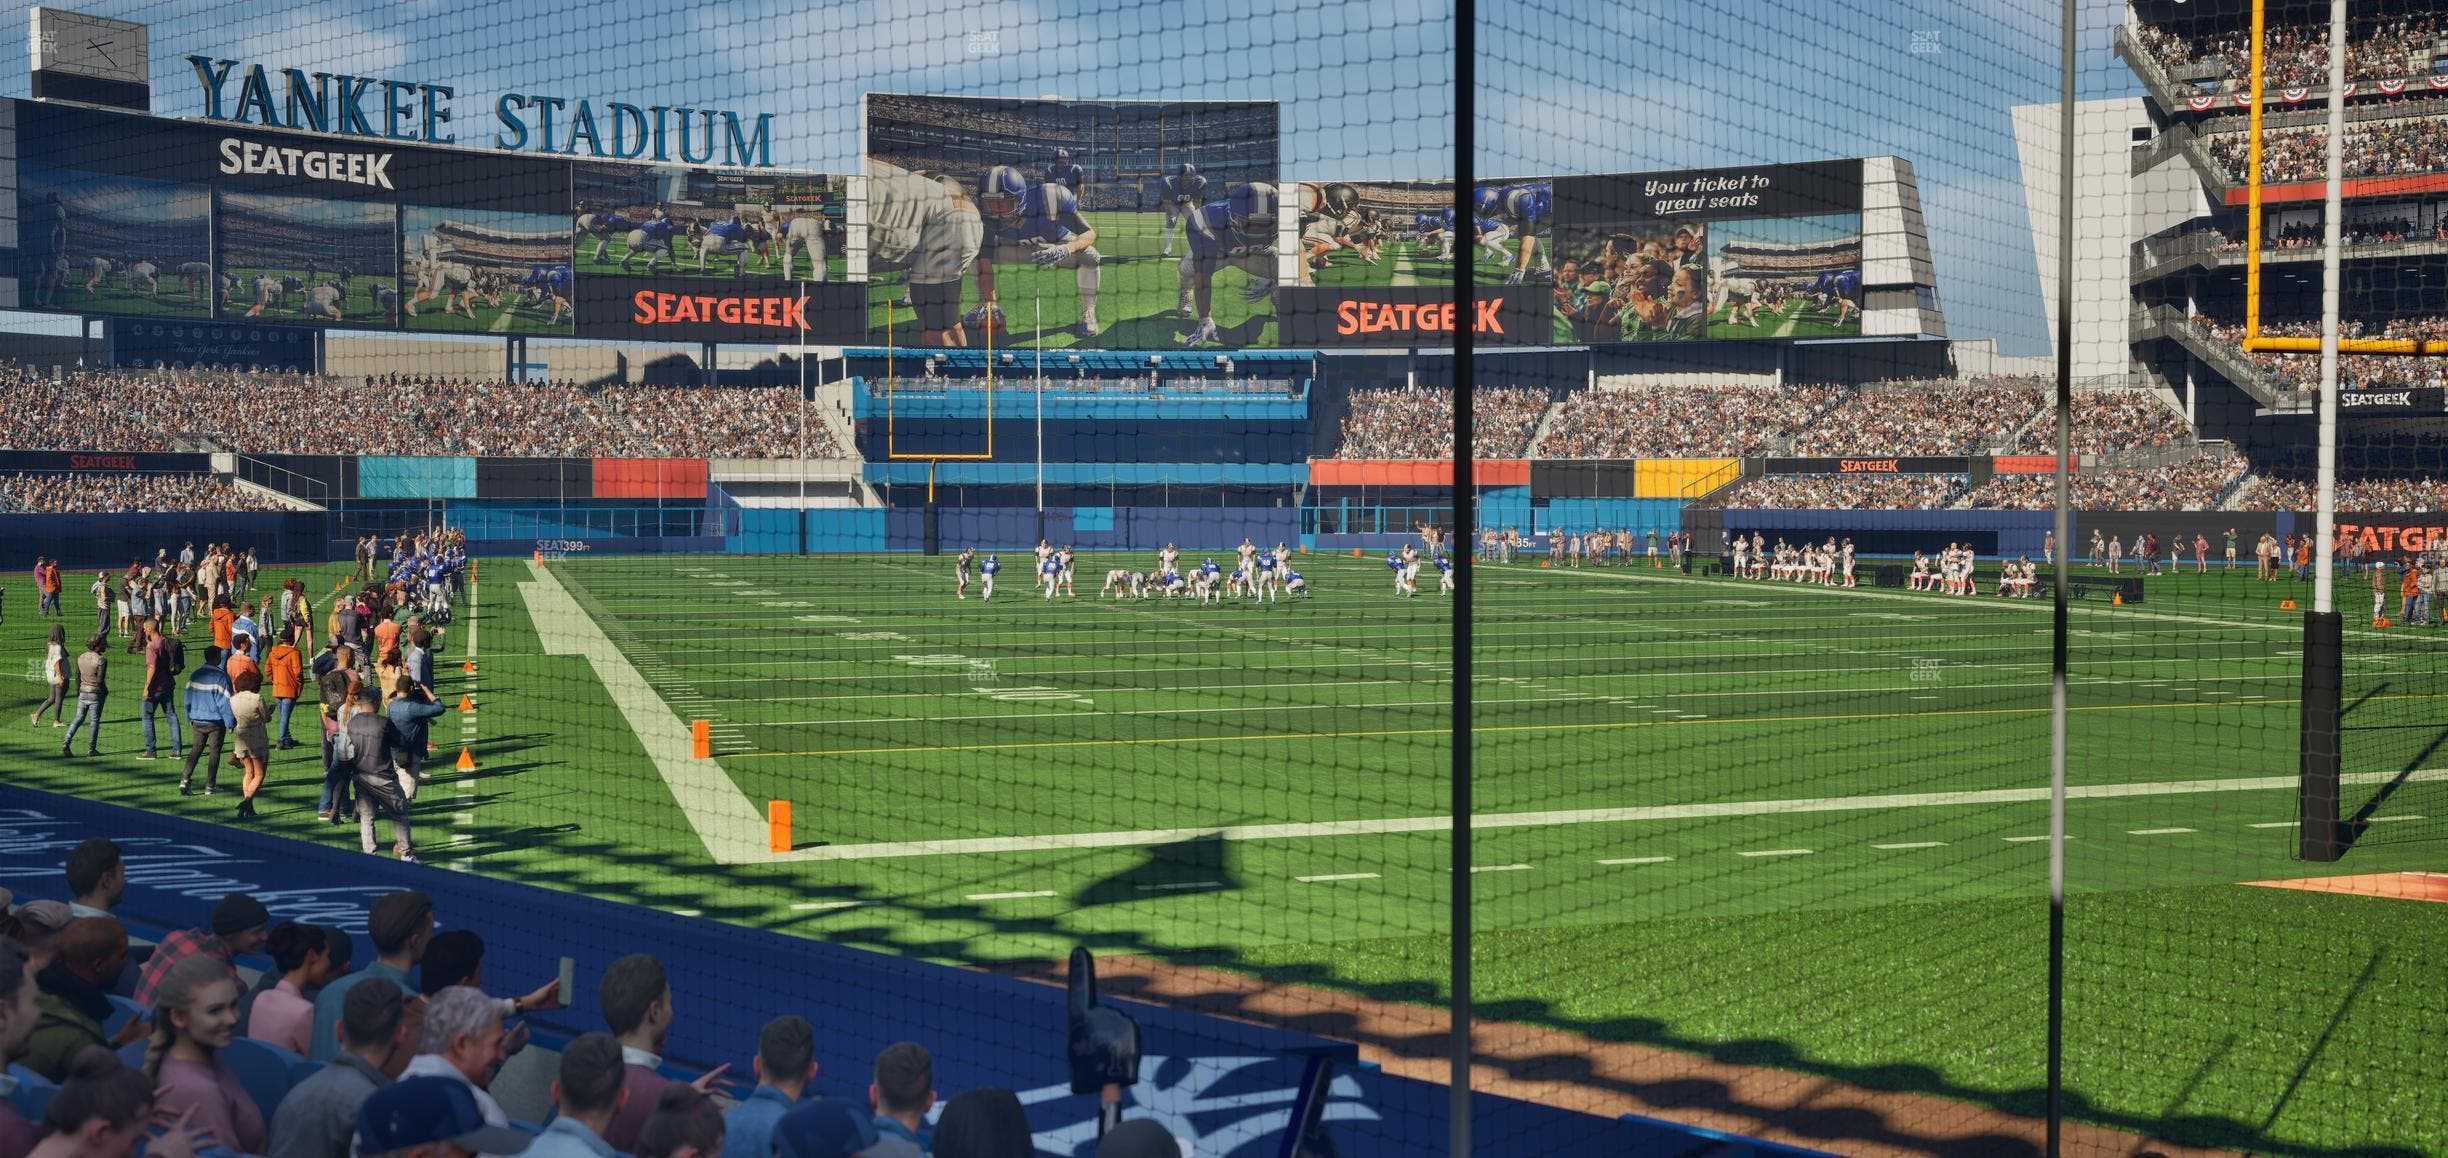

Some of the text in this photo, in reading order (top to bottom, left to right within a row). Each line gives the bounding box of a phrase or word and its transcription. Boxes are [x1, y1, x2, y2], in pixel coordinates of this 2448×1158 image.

[185, 55, 776, 167] YANKEE STADIUM
[219, 137, 395, 191] SEATGEEK
[1645, 174, 1770, 196] Your ticket to
[1655, 192, 1759, 215] great seats
[634, 290, 812, 330] SEATGEEK
[1337, 297, 1504, 335] SEATGEK
[2341, 391, 2411, 407] SEATGEEK
[70, 455, 136, 469] SEATGEEK
[1840, 459, 1898, 473] SEATGEEK
